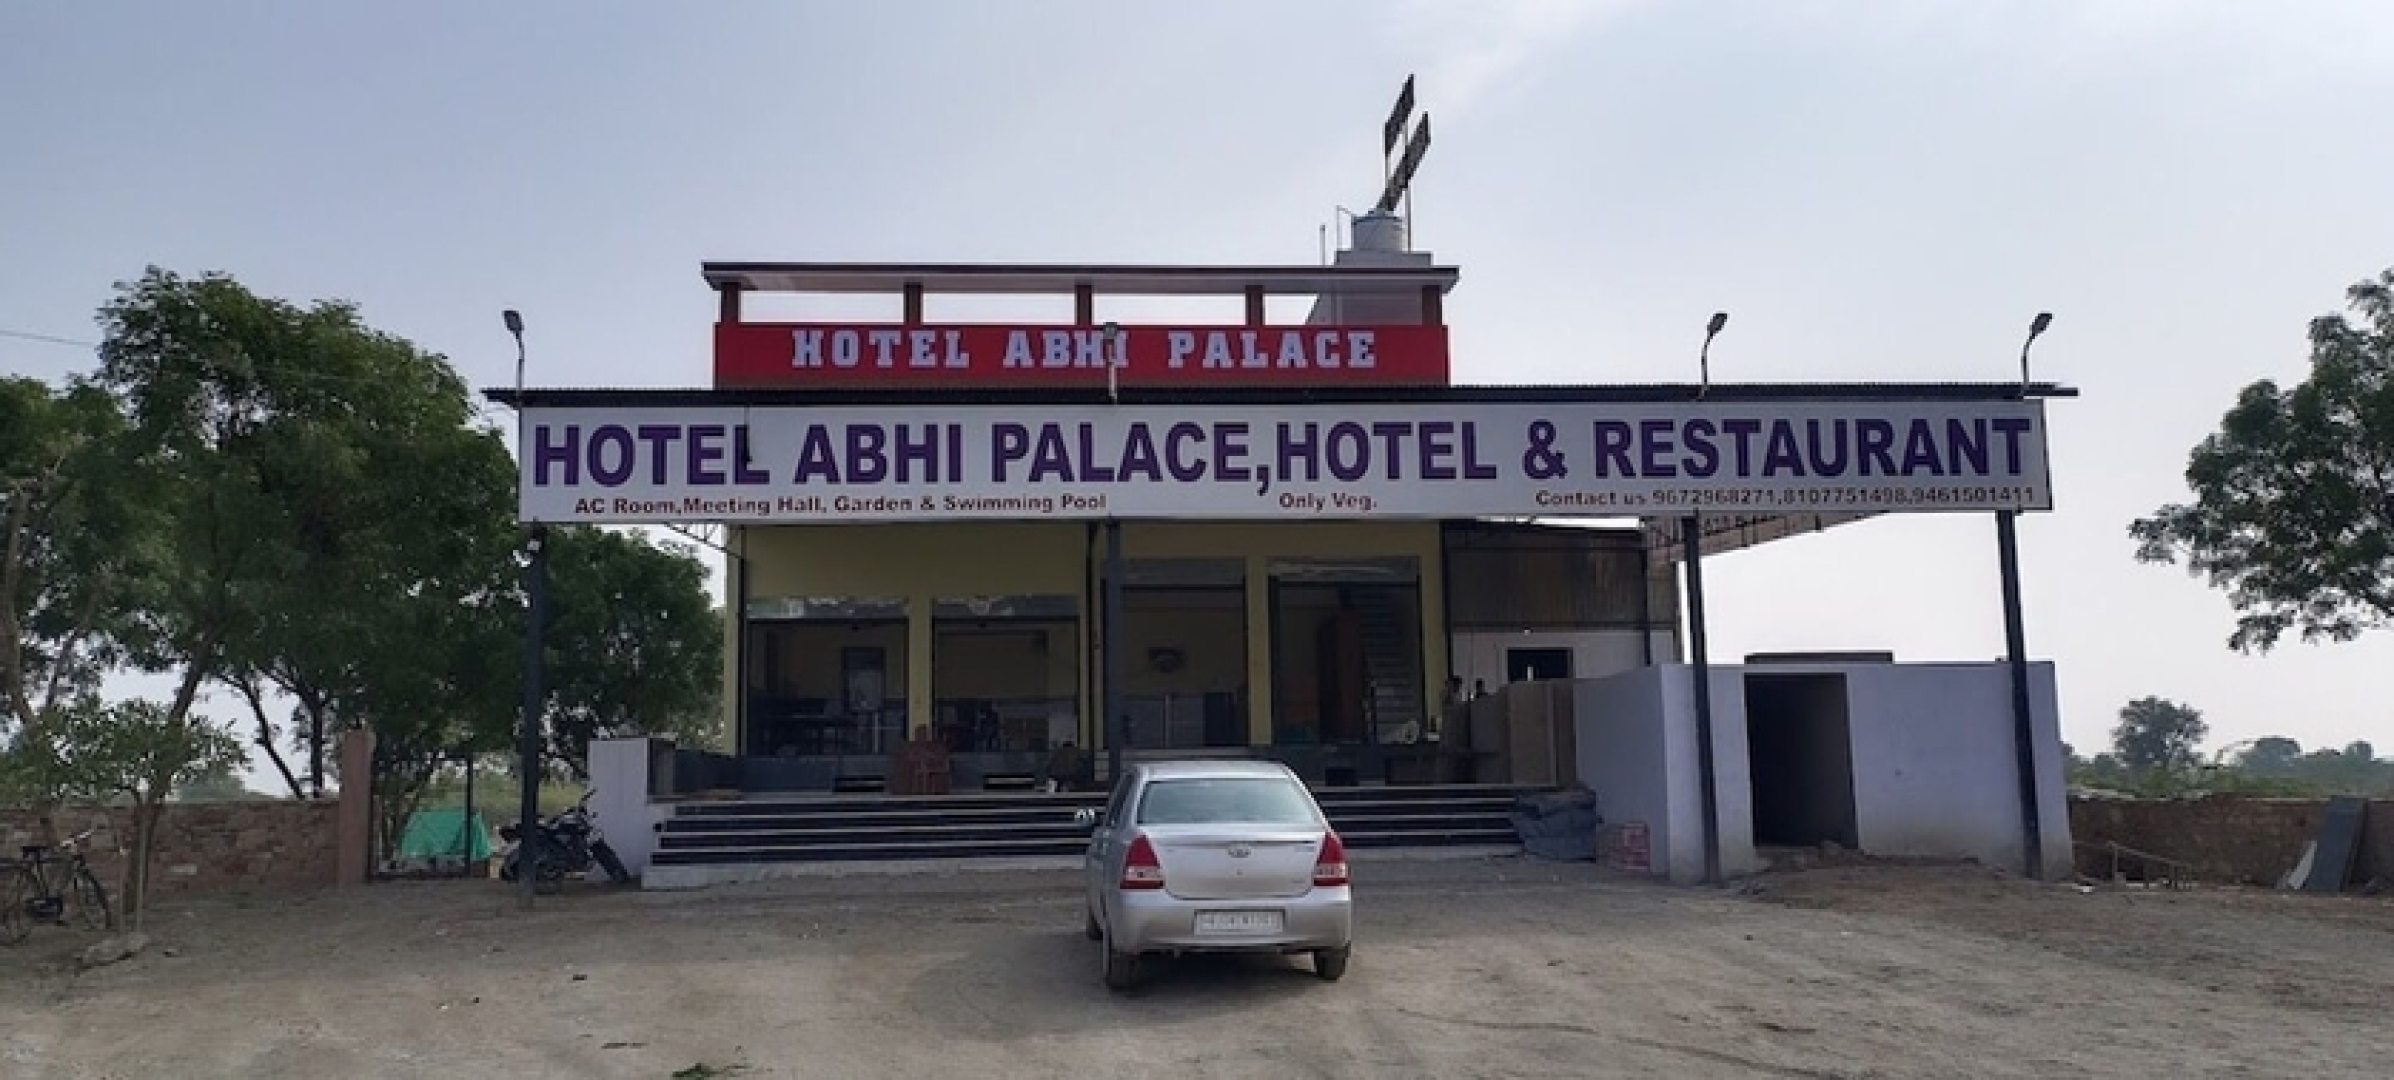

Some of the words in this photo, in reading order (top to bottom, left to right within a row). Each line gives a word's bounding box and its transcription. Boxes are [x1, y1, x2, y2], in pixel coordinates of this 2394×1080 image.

[792, 330, 970, 368] HOTEL
[1003, 330, 1129, 368] ABHI
[1168, 331, 1378, 368] PALACE
[534, 424, 770, 486] HOTEL
[793, 423, 963, 483] ABHI
[1522, 420, 1568, 479] &
[1594, 418, 2031, 478] RESTAURANT
[575, 498, 605, 514] AC
[834, 495, 913, 513] Garden
[920, 496, 936, 511] &
[943, 494, 1053, 513] Swimming
[1061, 493, 1107, 510] Pool
[1278, 492, 1326, 511] Only
[1332, 492, 1378, 510] Veg.
[1535, 489, 1617, 506] Contact
[1624, 493, 1647, 505] us
